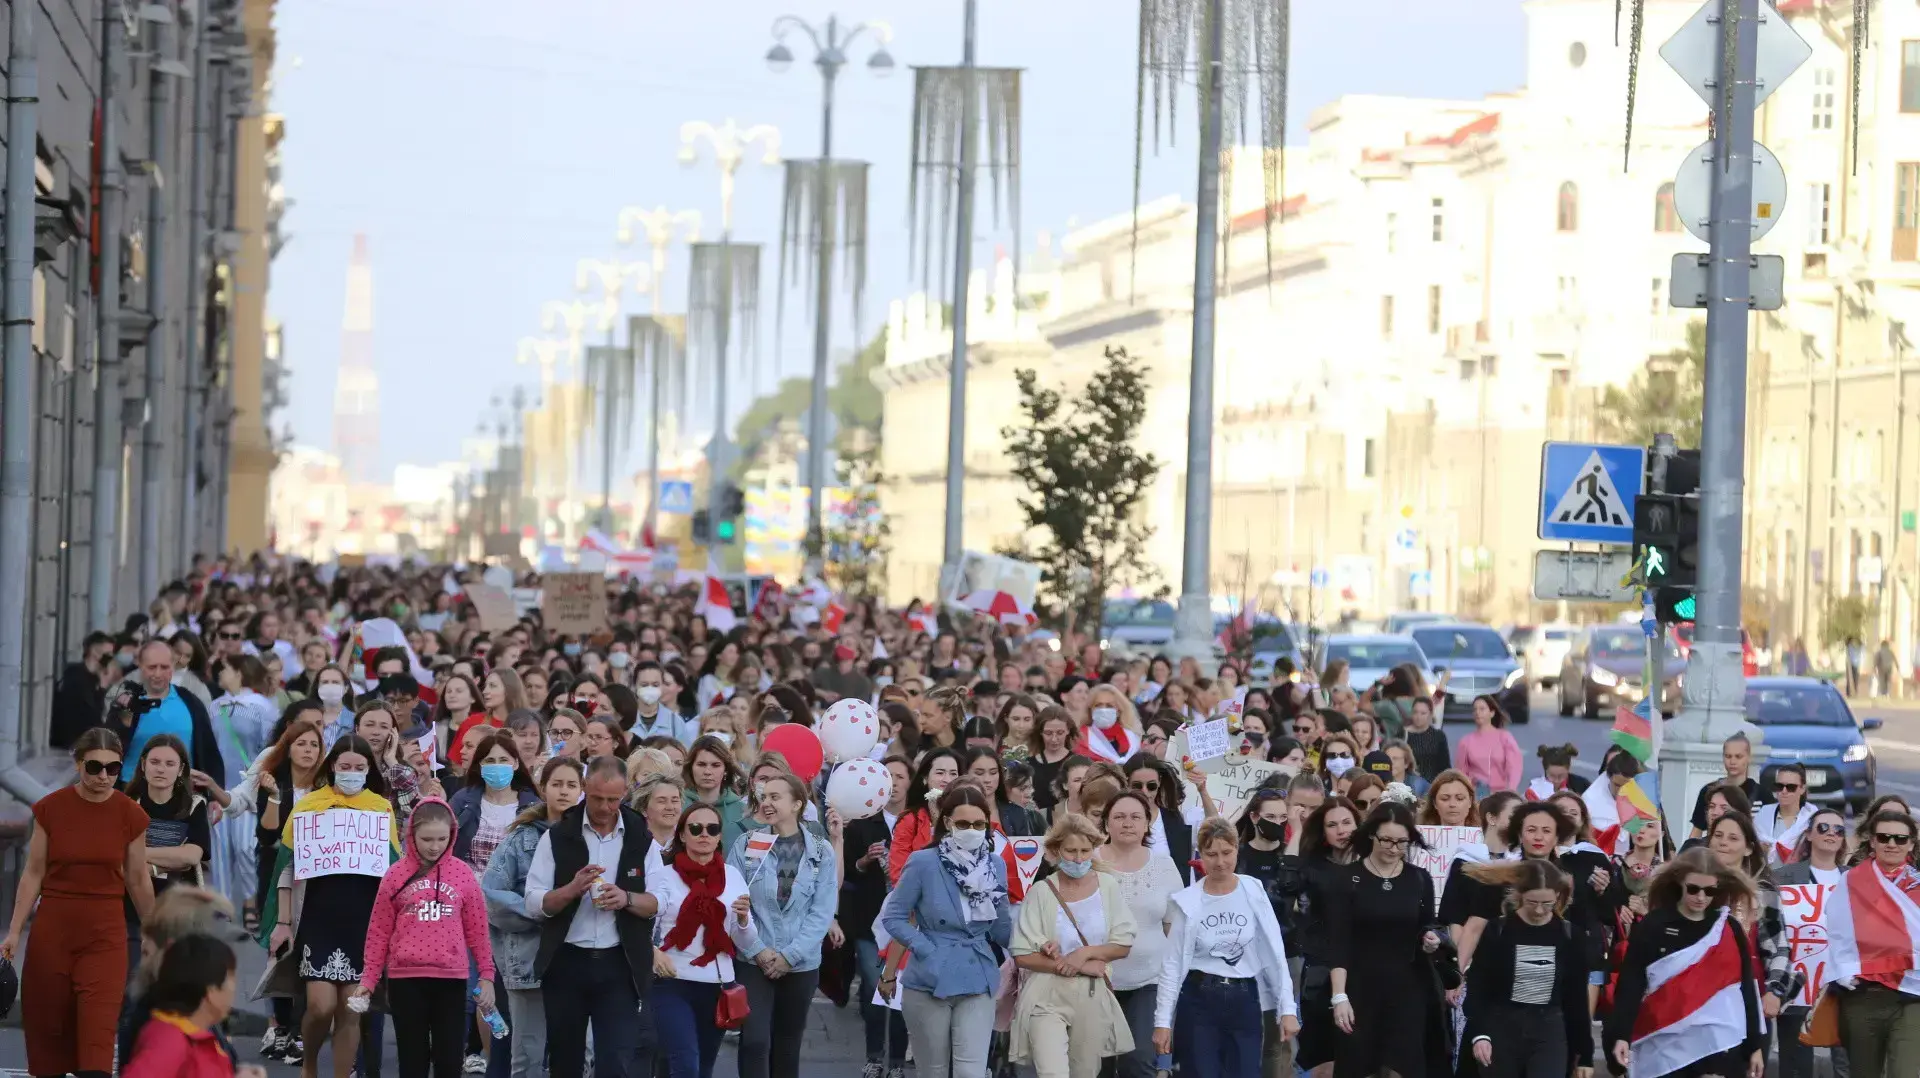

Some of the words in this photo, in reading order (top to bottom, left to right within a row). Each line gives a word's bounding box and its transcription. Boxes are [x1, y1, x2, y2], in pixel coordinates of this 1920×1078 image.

[293, 813, 326, 842] THE
[314, 856, 341, 872] FOR
[348, 857, 361, 870] U
[417, 900, 442, 922] 28
[1200, 911, 1248, 931] TOKYO
